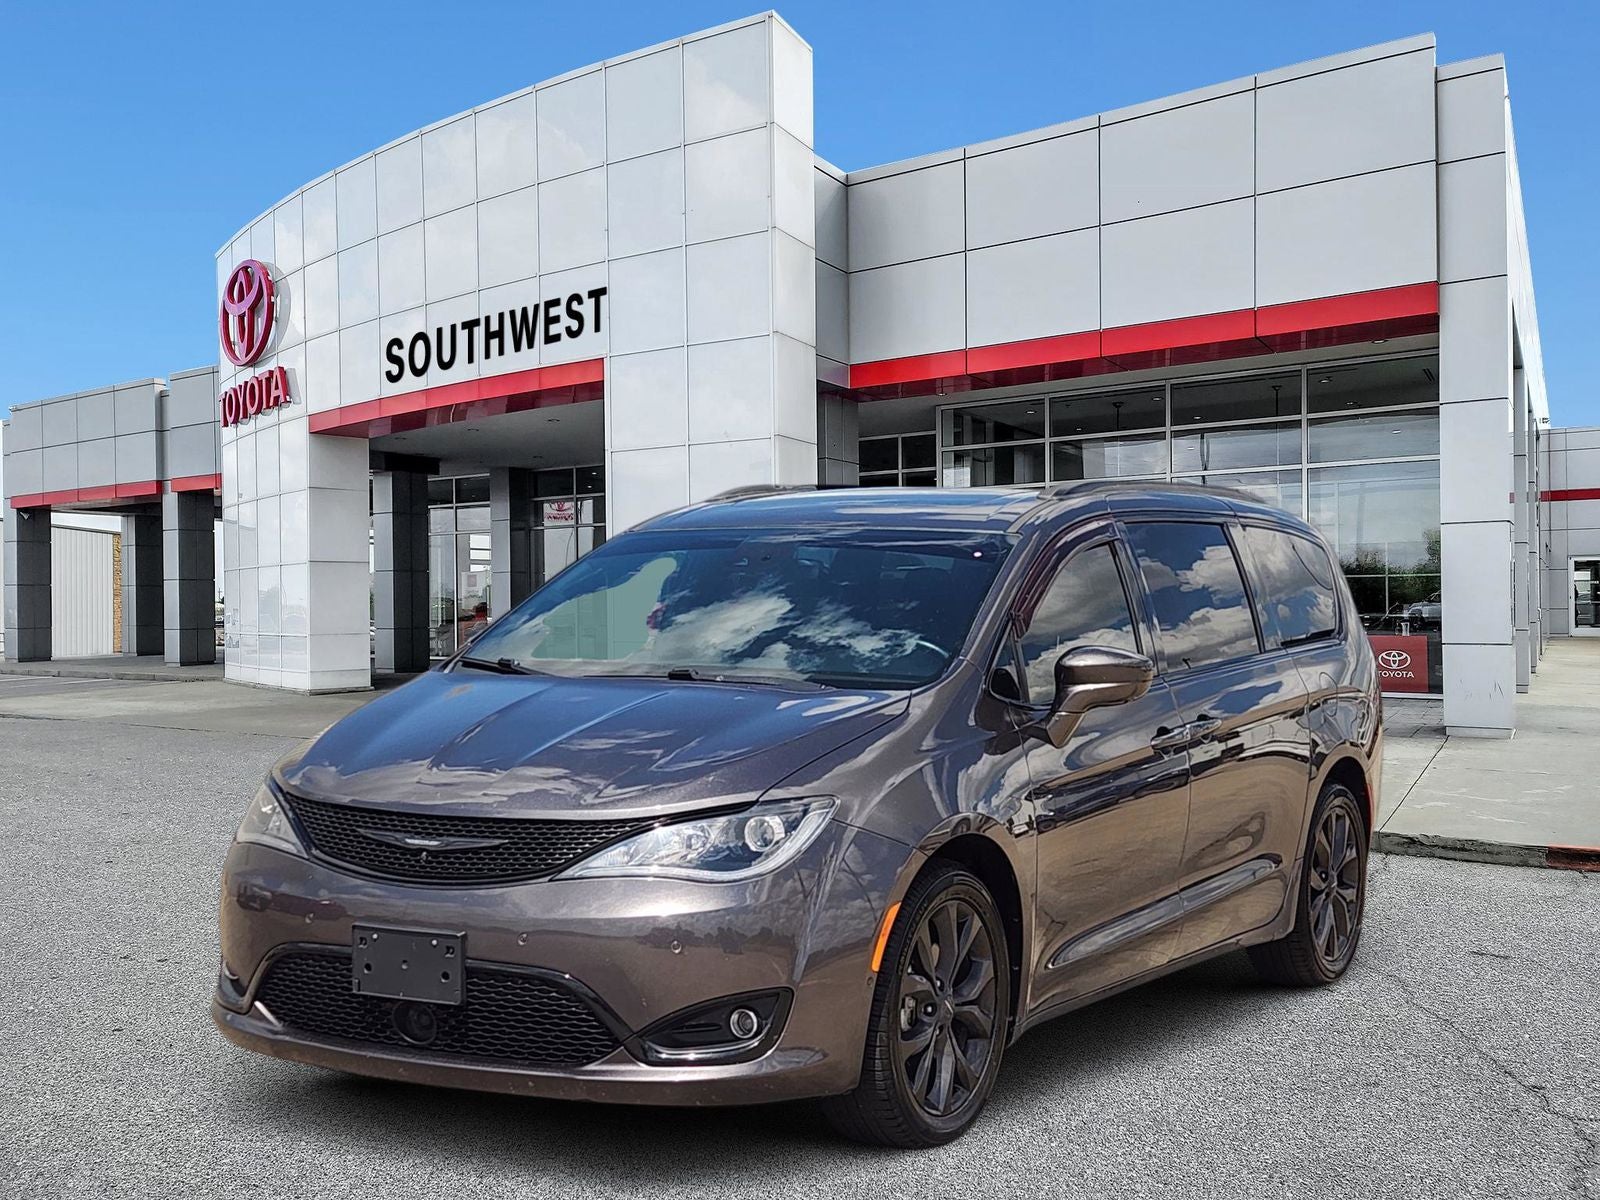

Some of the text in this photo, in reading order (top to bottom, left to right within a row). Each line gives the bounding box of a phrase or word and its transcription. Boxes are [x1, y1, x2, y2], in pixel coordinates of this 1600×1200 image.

[385, 286, 608, 384] SOUTHWEST
[218, 366, 290, 428] TOYOTA
[1378, 670, 1415, 678] TOYOTA
